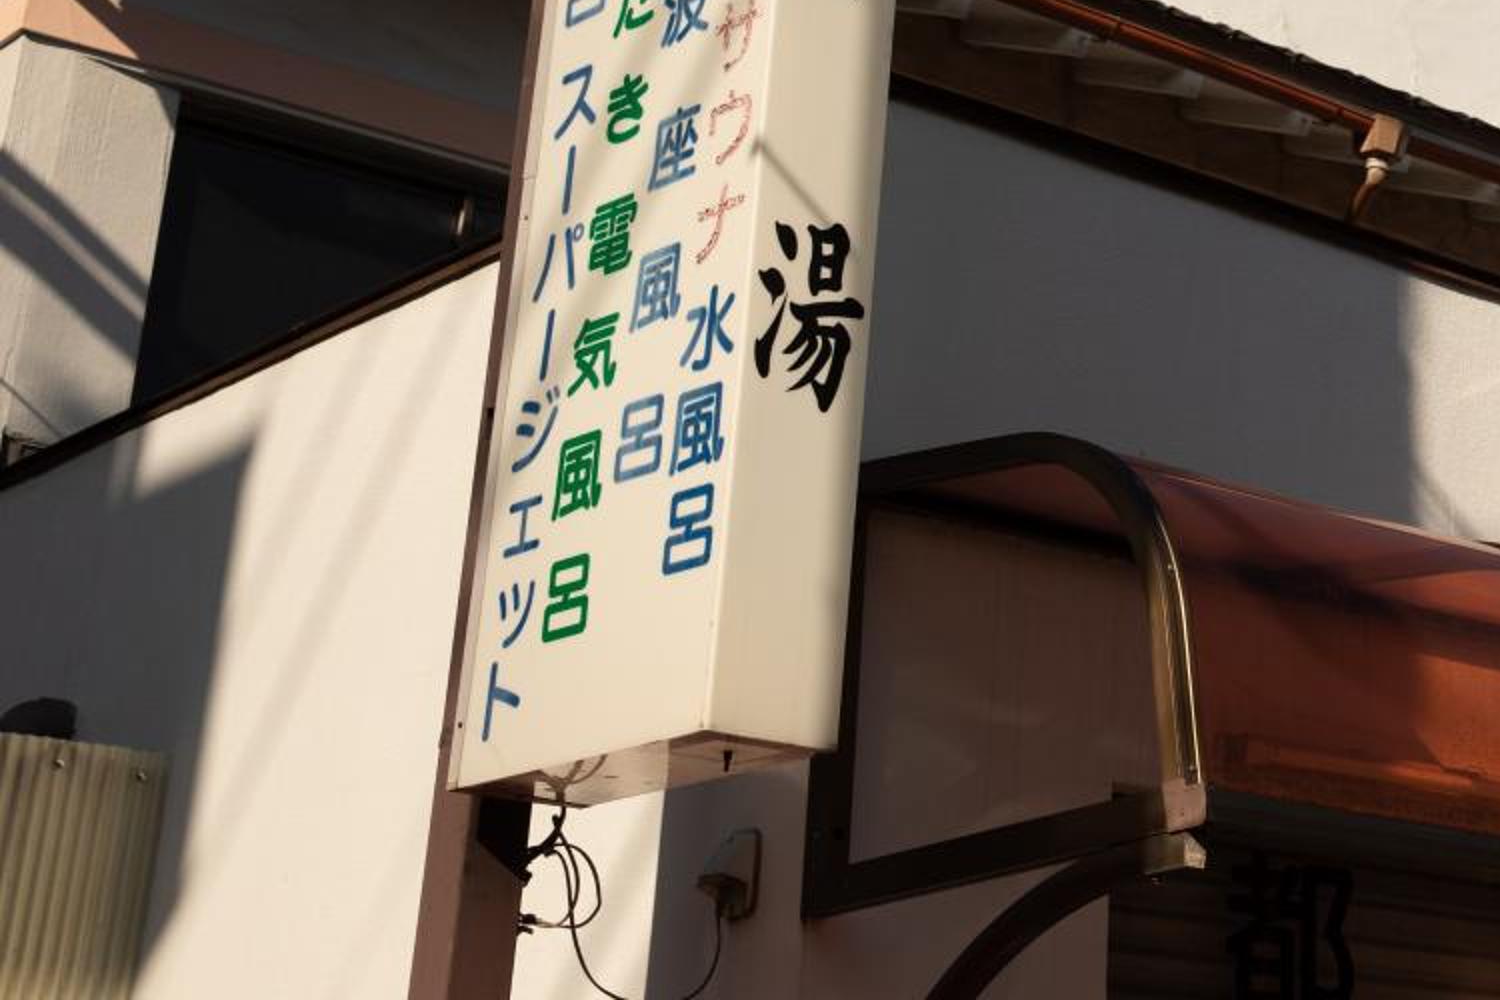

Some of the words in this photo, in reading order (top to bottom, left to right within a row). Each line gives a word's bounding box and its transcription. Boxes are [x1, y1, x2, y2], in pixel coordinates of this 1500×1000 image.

[482, 64, 597, 742] スーパージェット
[662, 285, 736, 577] 水風呂
